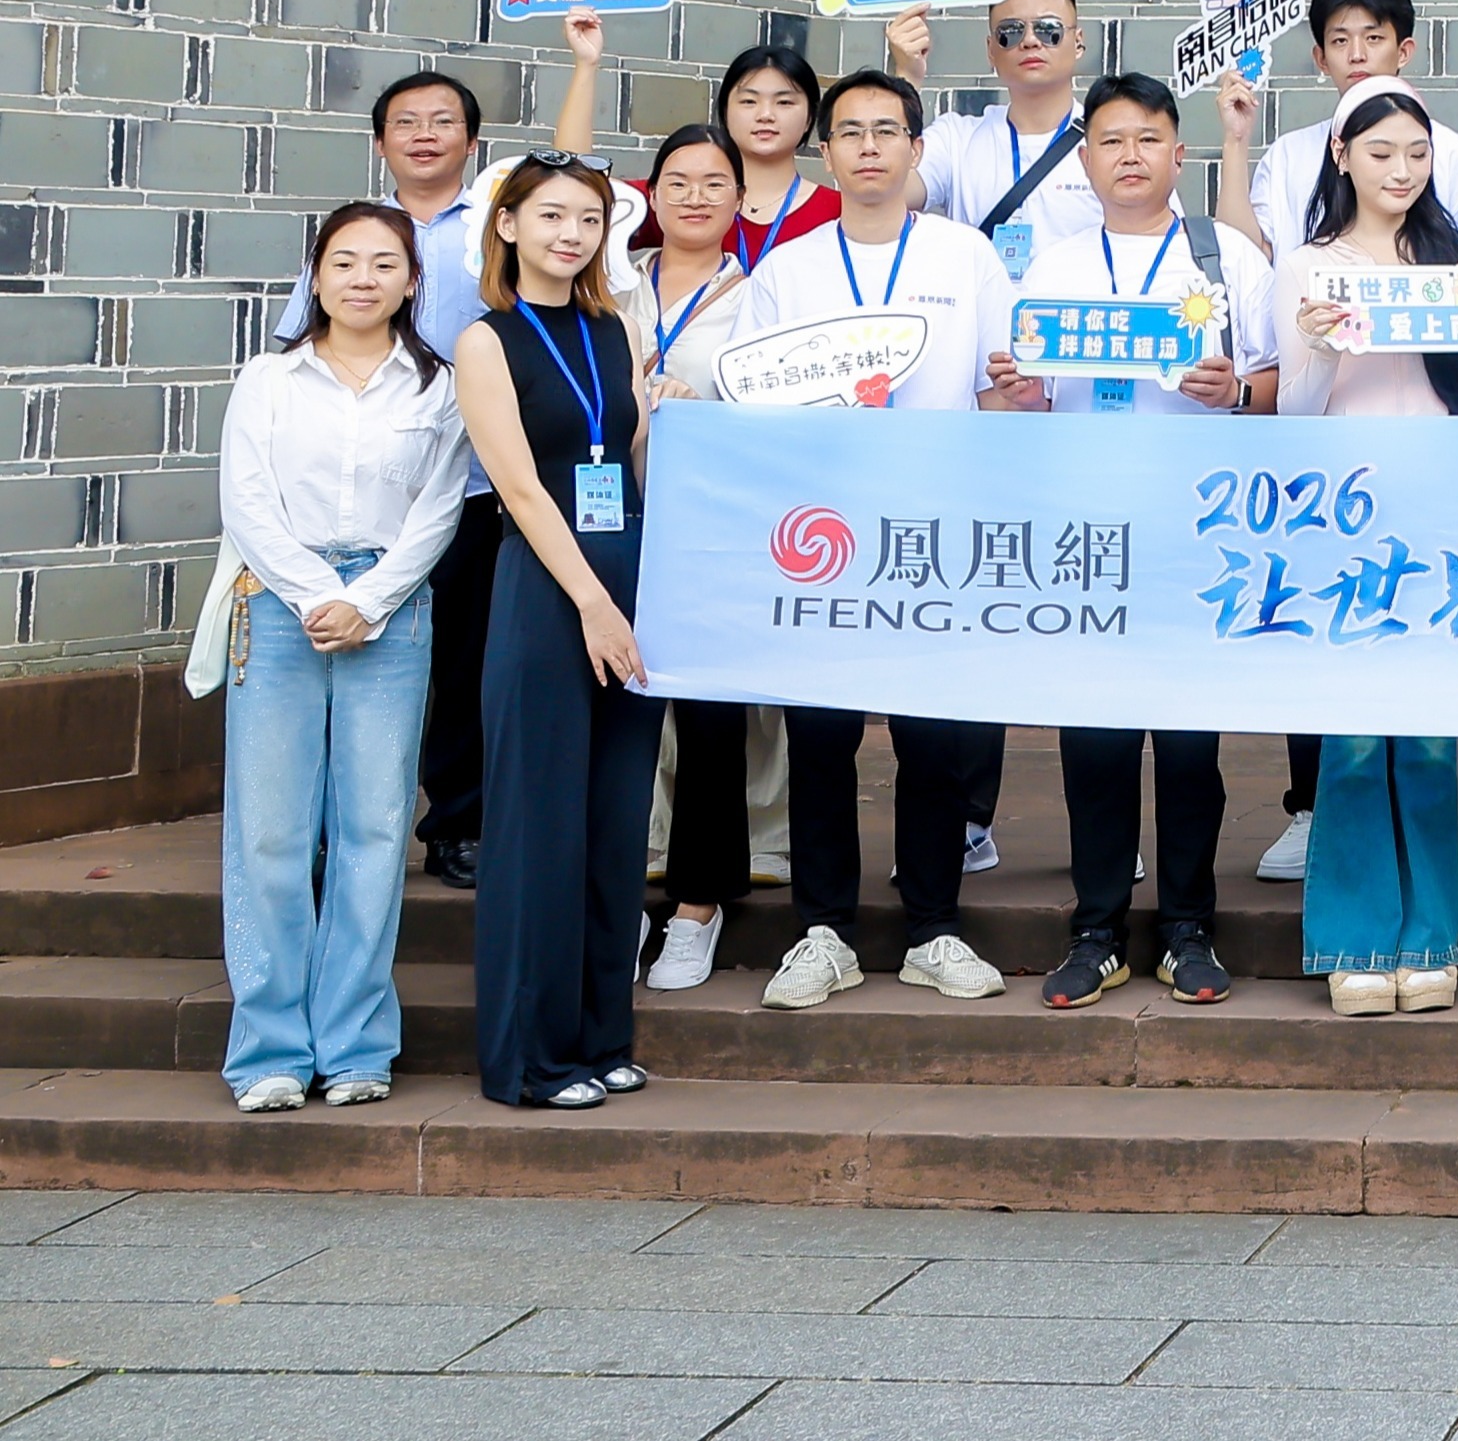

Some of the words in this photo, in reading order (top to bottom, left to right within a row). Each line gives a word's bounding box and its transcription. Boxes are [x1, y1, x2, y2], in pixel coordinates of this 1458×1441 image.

[1181, 46, 1224, 92] NAN
[1327, 277, 1413, 303] 让世界
[1060, 308, 1130, 332] 请你吃
[1058, 335, 1178, 359] 拌粉瓦罐汤
[1194, 466, 1378, 536] 2026
[866, 515, 1130, 593] 鳳凰網
[772, 596, 1127, 635] IFENG.COM
